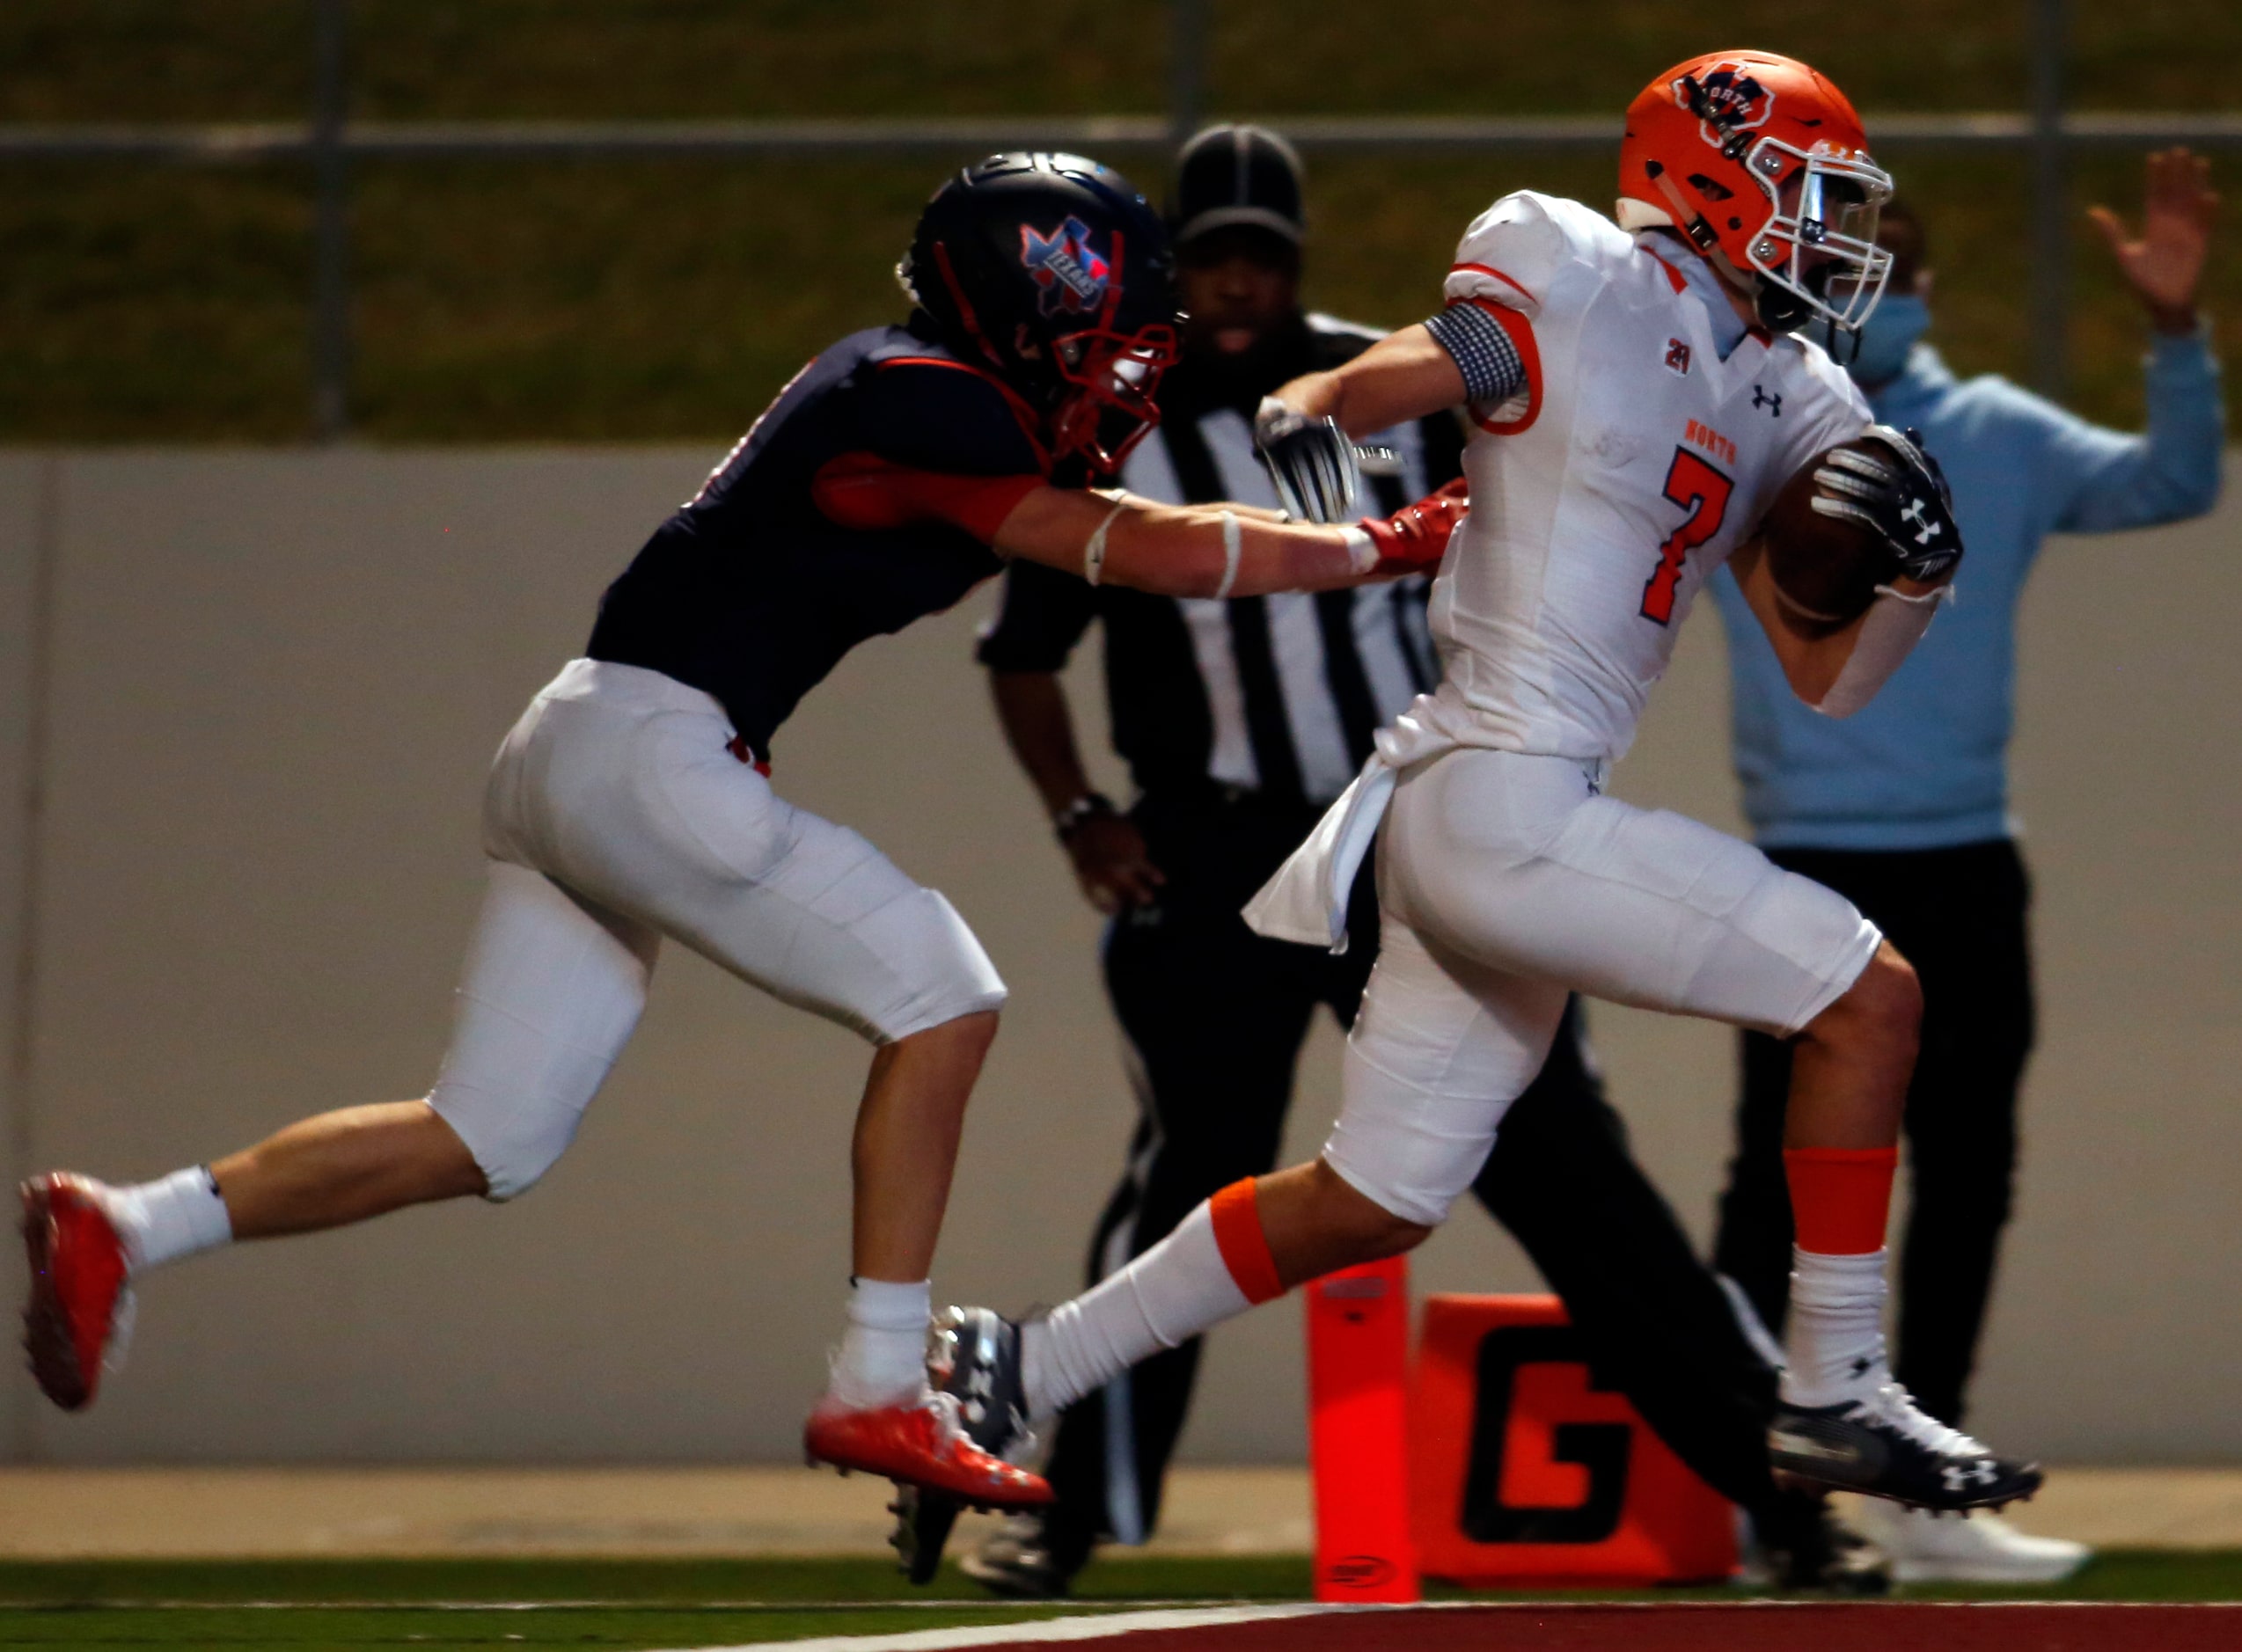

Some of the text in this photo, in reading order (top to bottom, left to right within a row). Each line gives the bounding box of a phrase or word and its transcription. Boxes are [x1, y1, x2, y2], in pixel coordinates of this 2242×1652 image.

[1703, 86, 1753, 115] ORTH
[1684, 418, 1736, 465] NORTH
[1639, 444, 1735, 628] 7
[1458, 1325, 1634, 1545] G
